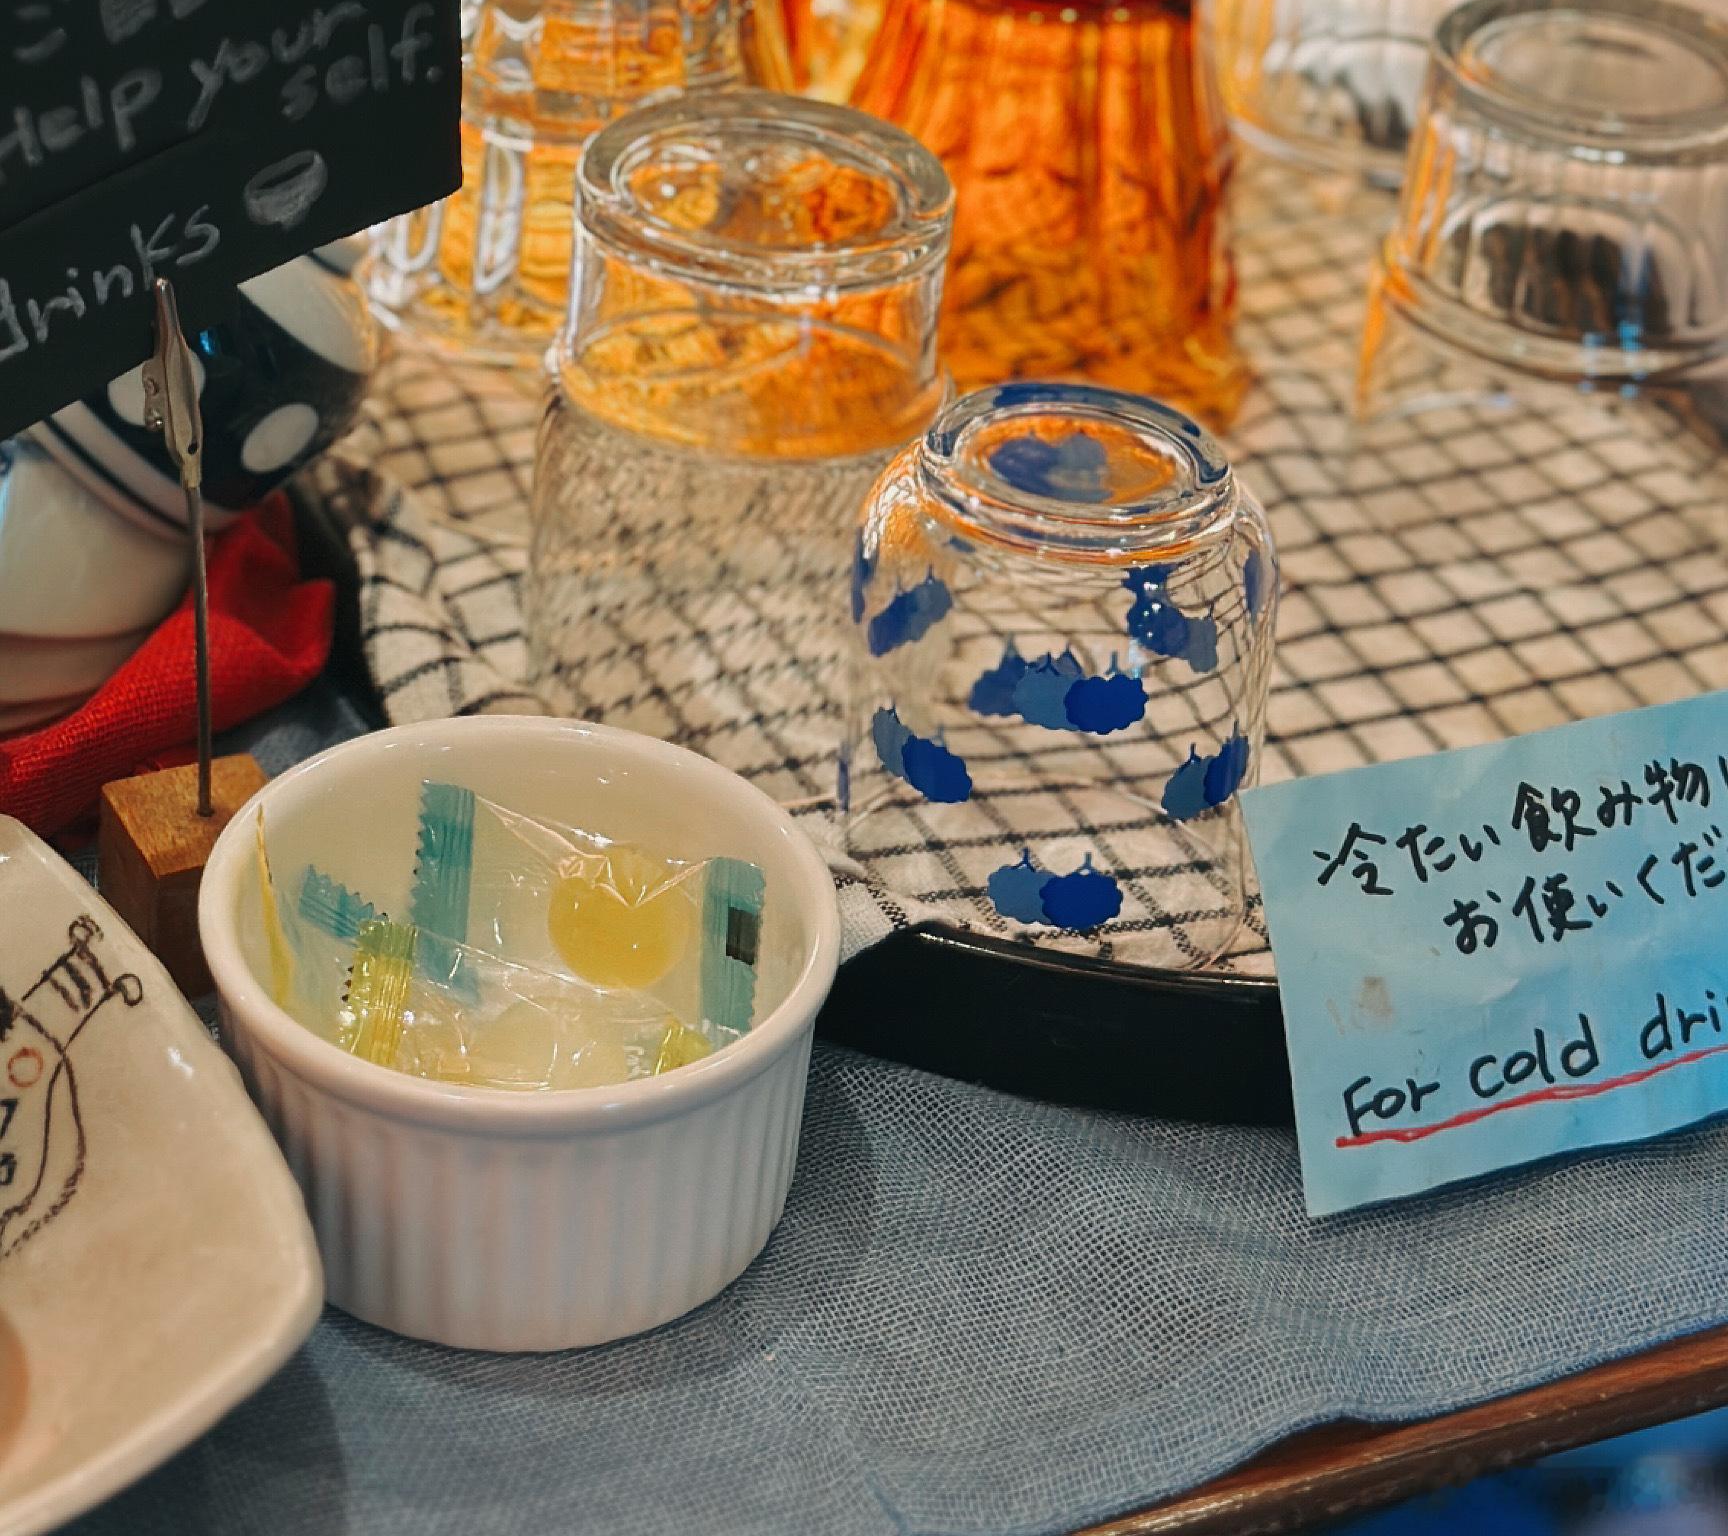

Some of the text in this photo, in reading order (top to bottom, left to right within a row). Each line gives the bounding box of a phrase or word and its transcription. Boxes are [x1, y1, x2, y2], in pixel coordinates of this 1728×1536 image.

[189, 1, 367, 131] your
[280, 3, 443, 121] self.
[1313, 755, 1728, 896] 冷たい飲み物
[1443, 824, 1728, 954] お使いくだ
[1343, 990, 1728, 1137] For cold dri
